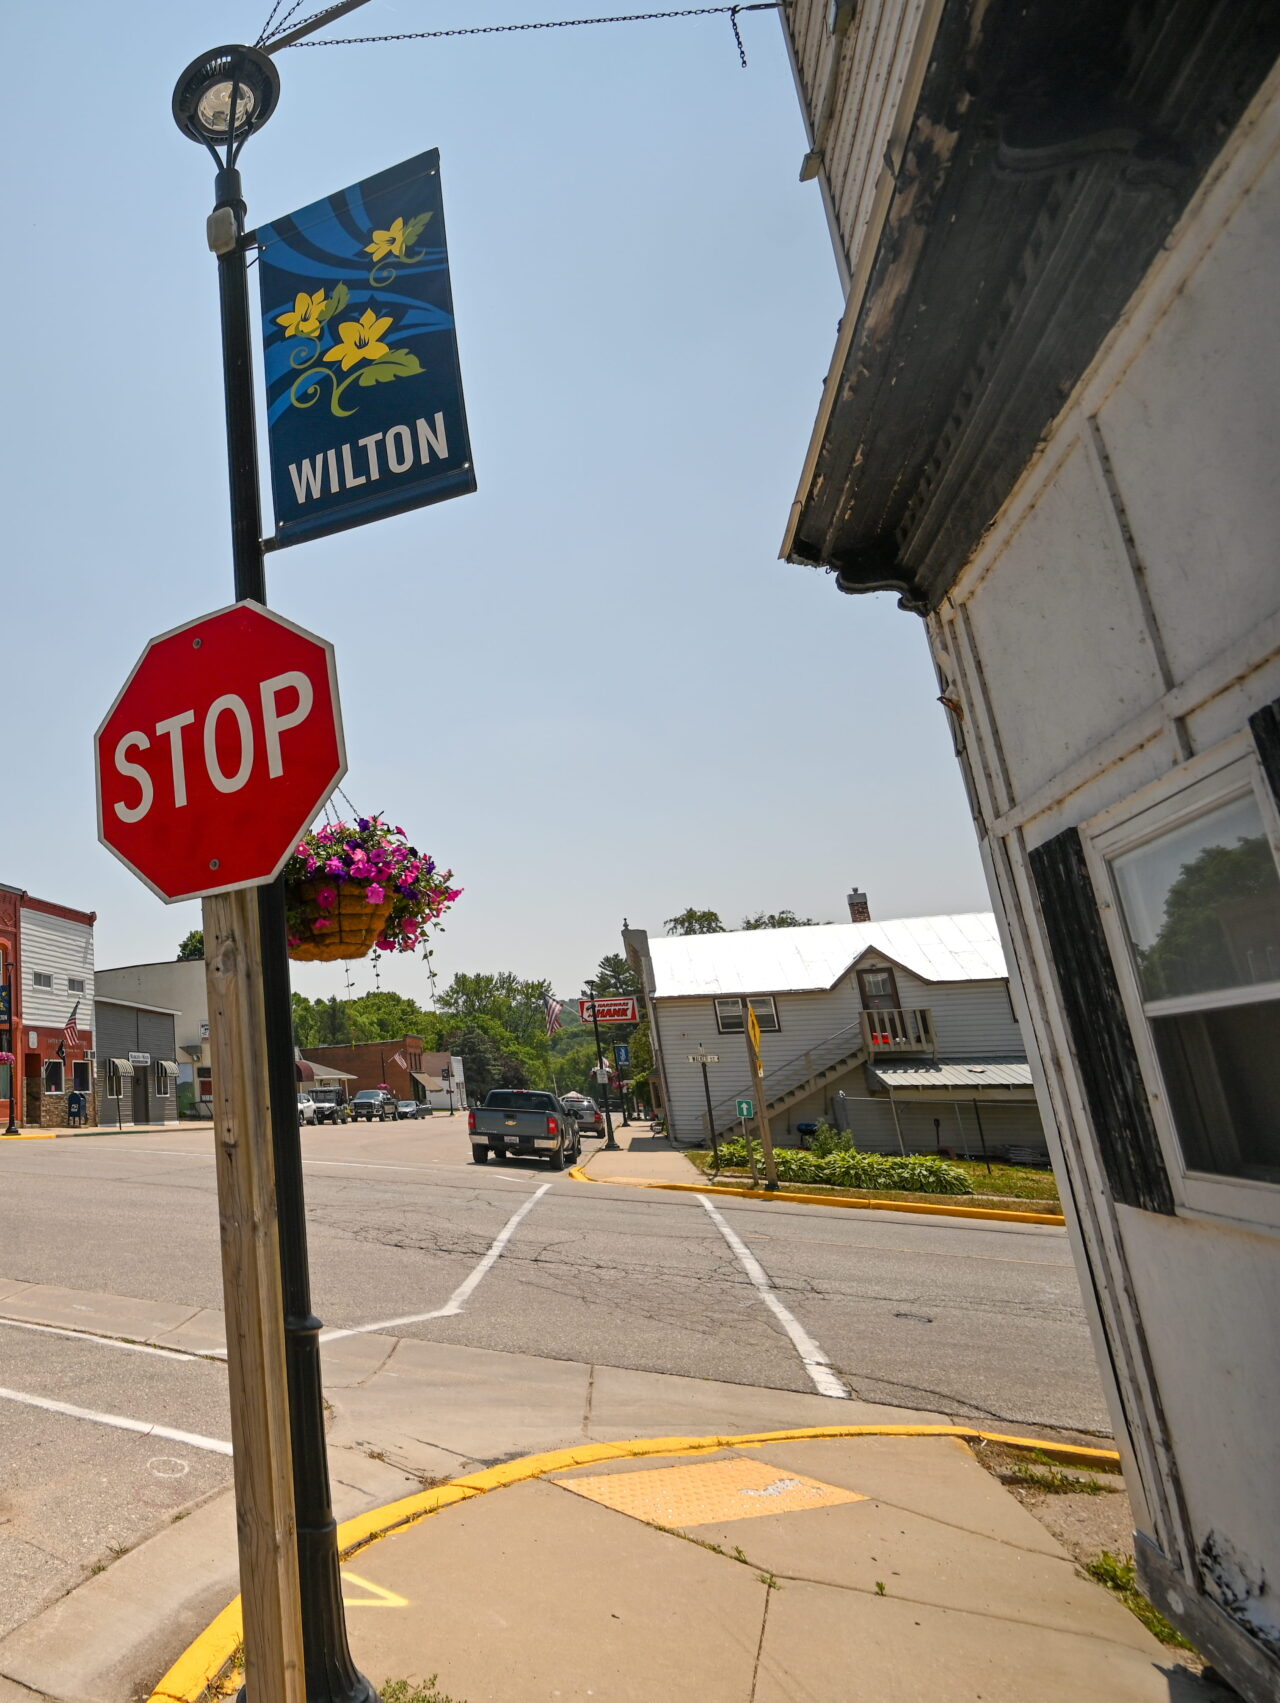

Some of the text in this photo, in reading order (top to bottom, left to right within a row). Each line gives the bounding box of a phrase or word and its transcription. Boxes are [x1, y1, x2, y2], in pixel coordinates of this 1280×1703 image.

[289, 411, 449, 504] WILTON
[114, 671, 314, 824] STOP
[596, 1007, 629, 1018] HANK
